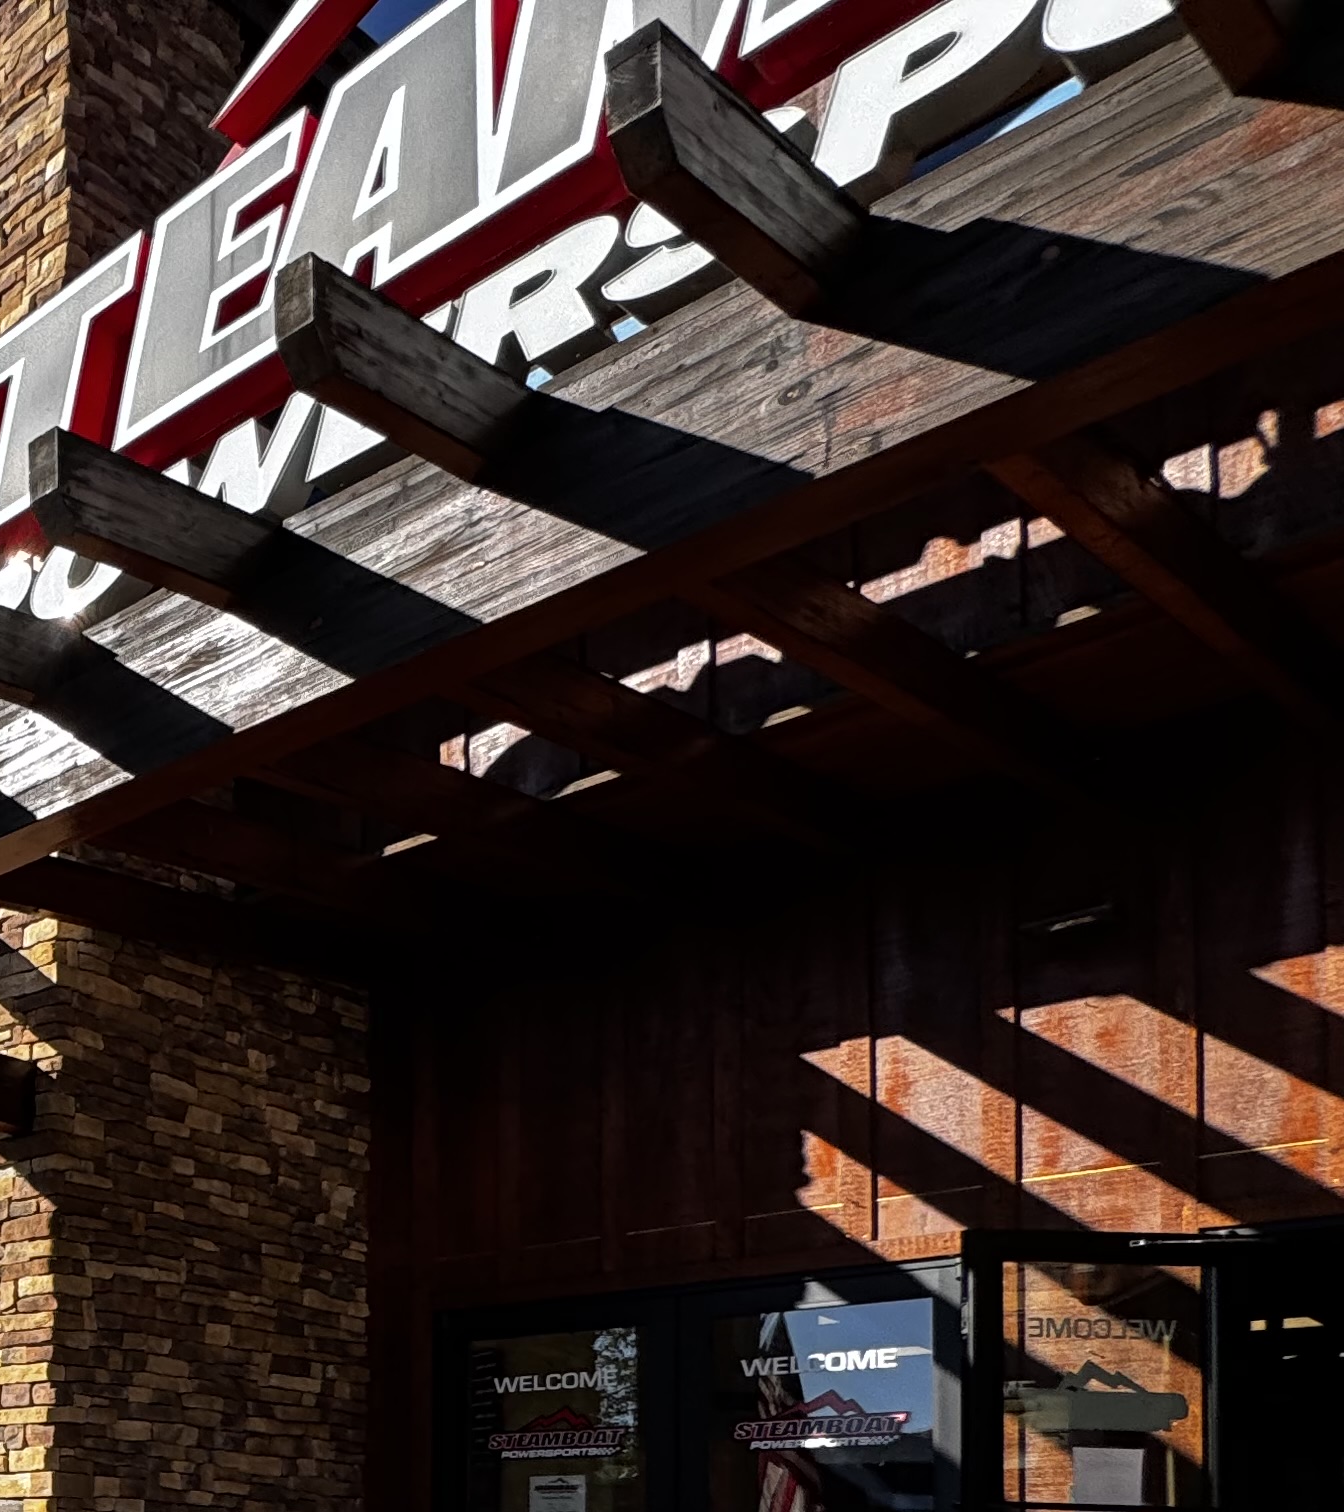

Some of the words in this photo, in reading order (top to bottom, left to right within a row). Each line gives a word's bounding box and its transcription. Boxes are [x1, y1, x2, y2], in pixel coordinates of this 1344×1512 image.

[740, 1347, 899, 1378] WELCOME
[493, 1364, 618, 1394] WELCOME
[734, 1412, 910, 1440] STEAMBOAT
[488, 1428, 624, 1449] STEAMBOAT
[750, 1437, 872, 1450] POWERSPORTS
[501, 1448, 602, 1460] POWERSPORTS
